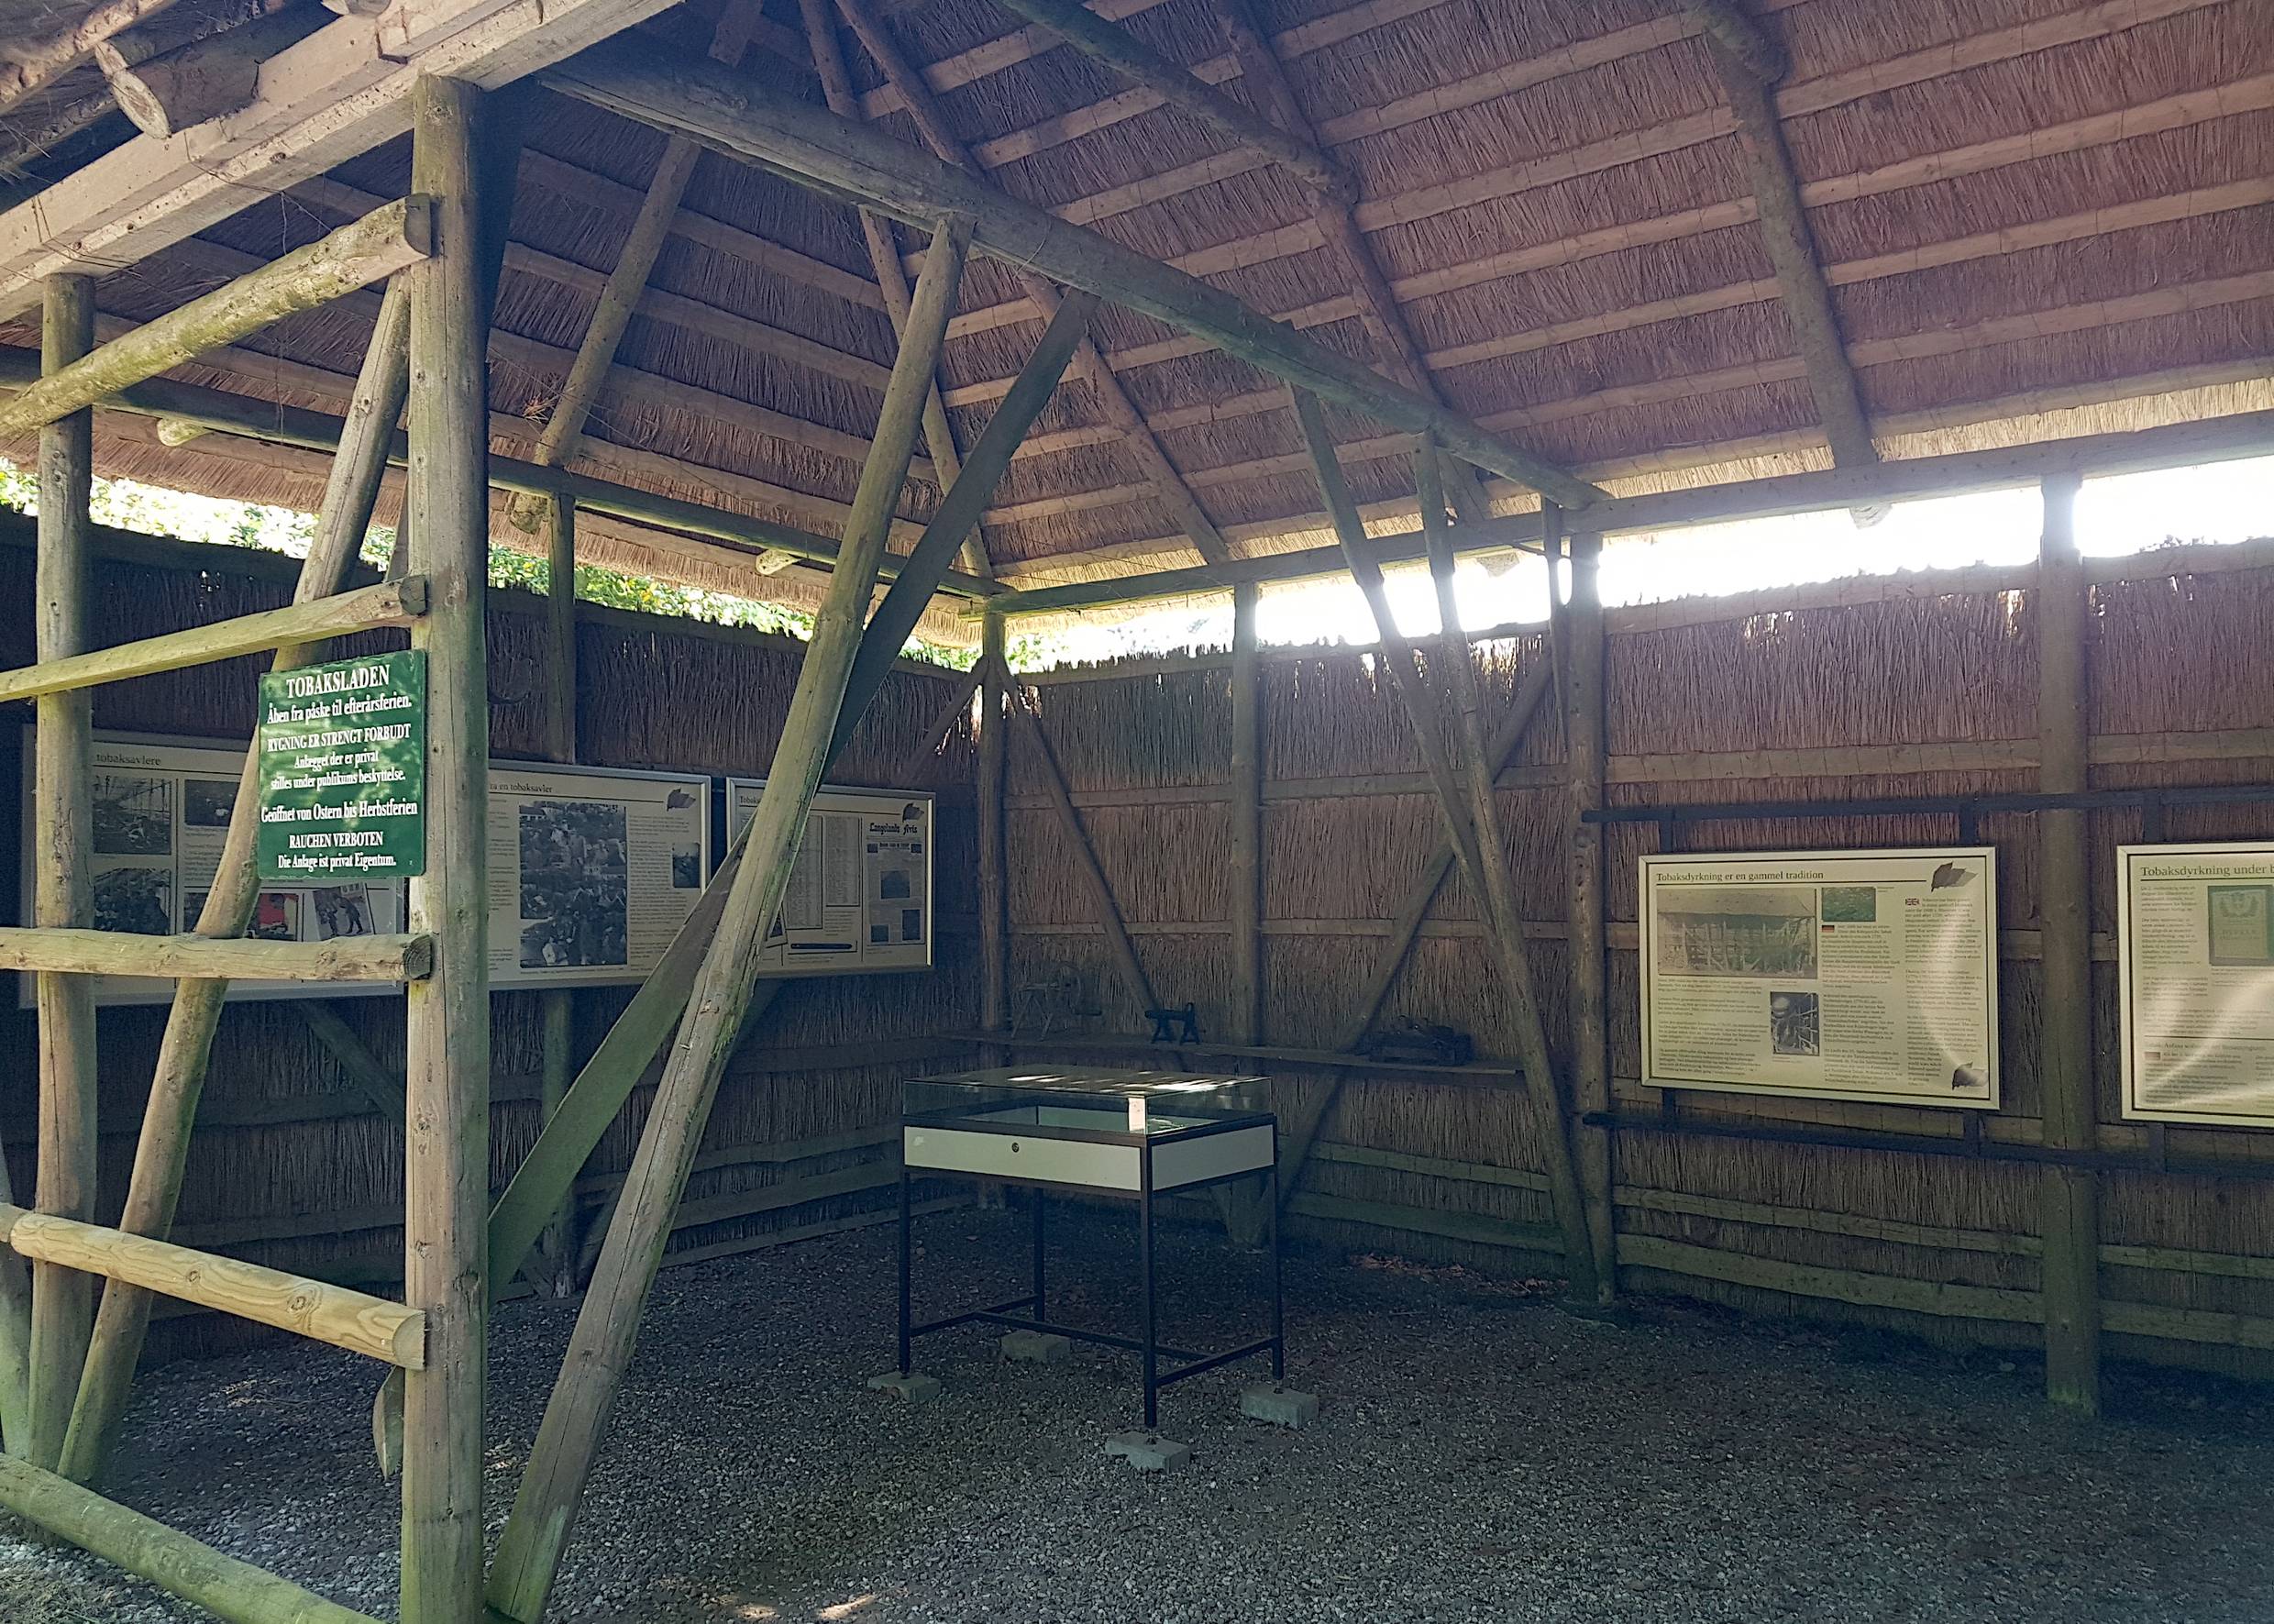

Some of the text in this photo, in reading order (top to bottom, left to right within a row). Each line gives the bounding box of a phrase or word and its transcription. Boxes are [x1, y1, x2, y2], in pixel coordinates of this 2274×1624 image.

[286, 664, 391, 699] TOBAKSLADEN
[267, 691, 413, 725] Åben fra påske til efterårsferien.
[267, 723, 412, 752] RYGNING ER STRENGT FORBUDT
[330, 751, 344, 767] der
[345, 754, 354, 765] er
[355, 748, 379, 768] privat
[293, 774, 316, 789] under
[316, 770, 359, 792] publikums
[359, 767, 406, 787] beskyttelse.
[260, 797, 418, 823] Geöffnet von Ostern bis Herbstferien
[289, 831, 384, 849] RAUCHEN VERBOTEN
[278, 851, 397, 872] Die Anlage ist privat Eigentum.
[2140, 866, 2231, 877] Tobaksdyrkning
[2234, 864, 2268, 874] under
[1656, 872, 1723, 881] Tobaksdyrkning
[1748, 870, 1784, 881] gammel
[1785, 870, 1825, 879] tradition
